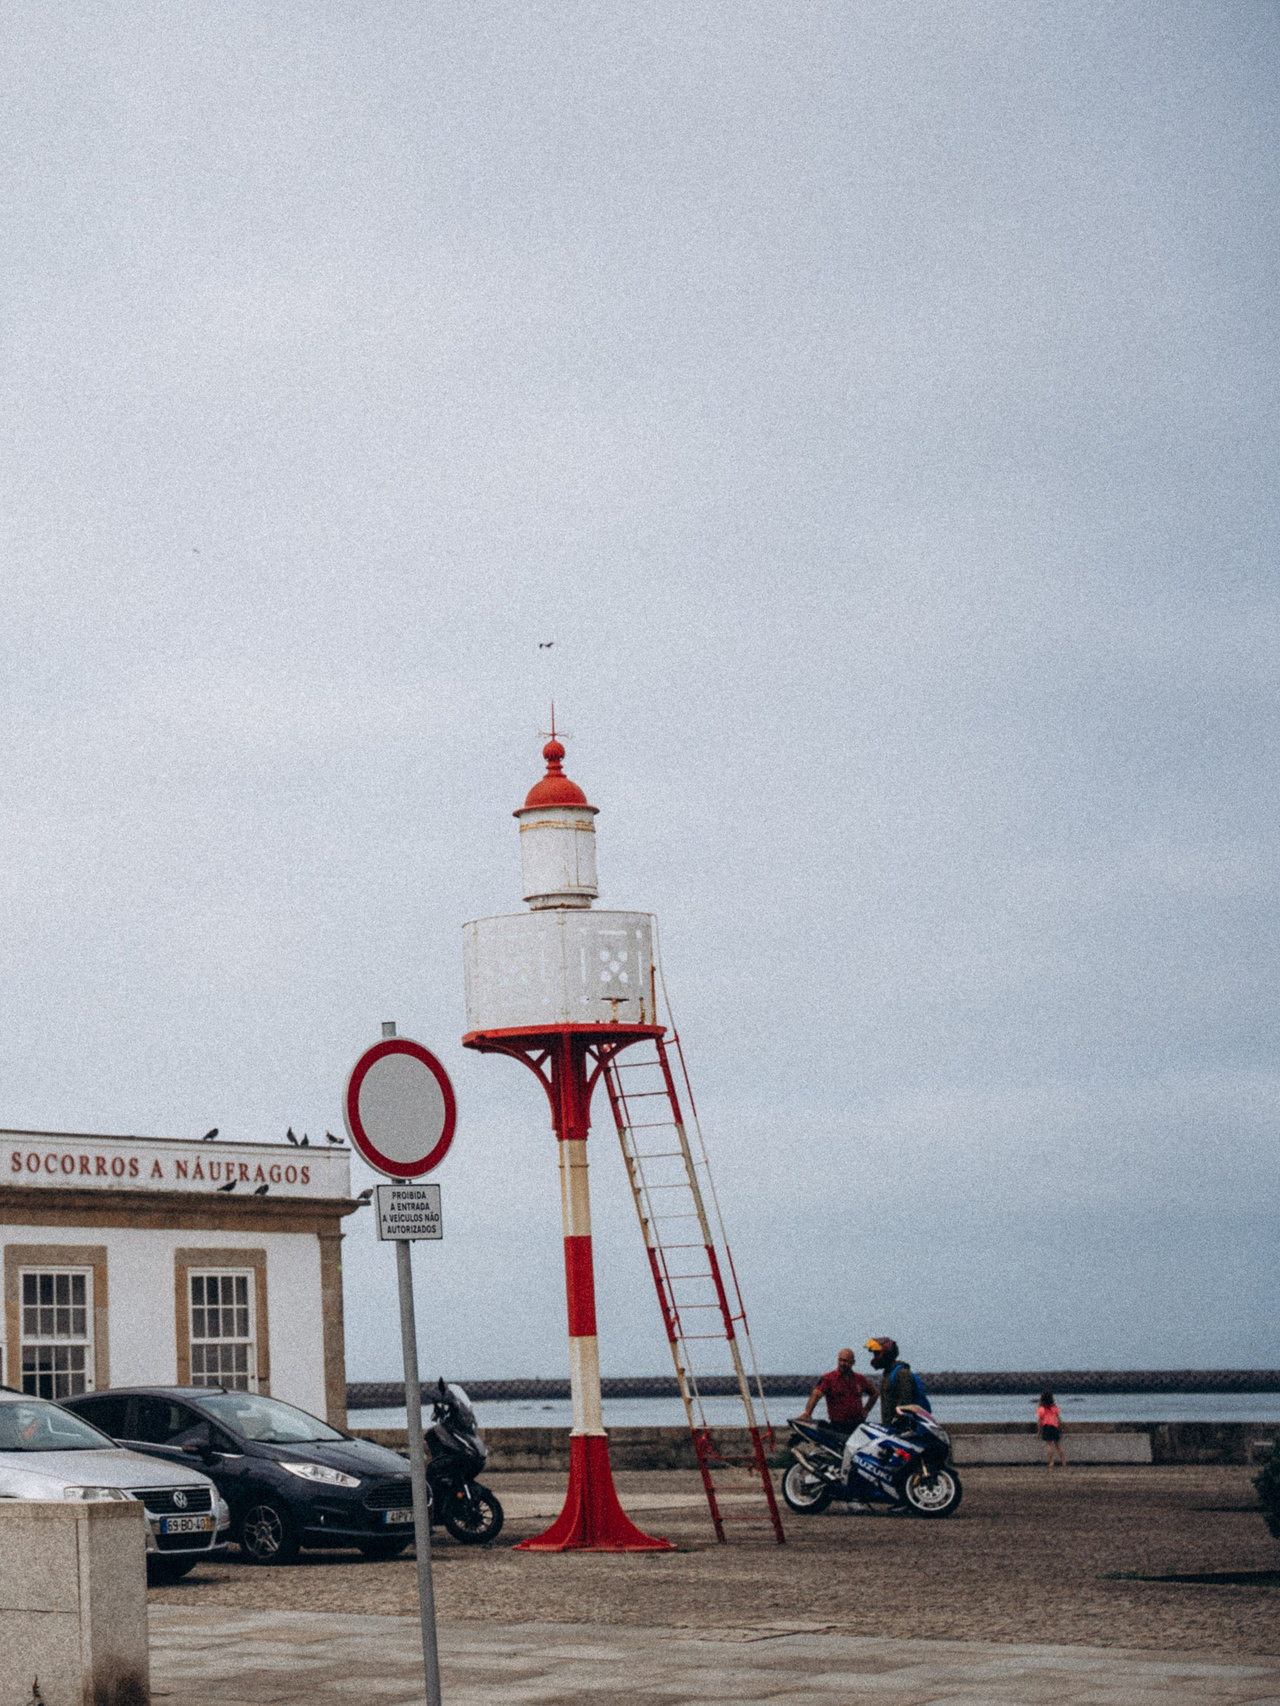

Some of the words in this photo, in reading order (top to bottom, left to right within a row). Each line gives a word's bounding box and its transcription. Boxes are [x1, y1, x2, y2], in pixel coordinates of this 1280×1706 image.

[11, 1151, 139, 1177] SOCORROS
[150, 1159, 164, 1179] A
[174, 1156, 311, 1185] NÁUFRAGOS
[392, 1191, 427, 1200] PROIBIDA
[390, 1202, 395, 1211] A
[397, 1202, 430, 1211] ENTRADA
[382, 1214, 387, 1223] A
[424, 1211, 440, 1222] NÃO
[387, 1225, 437, 1234] AUTORIZADOS
[852, 1454, 894, 1482] SUZUKI
